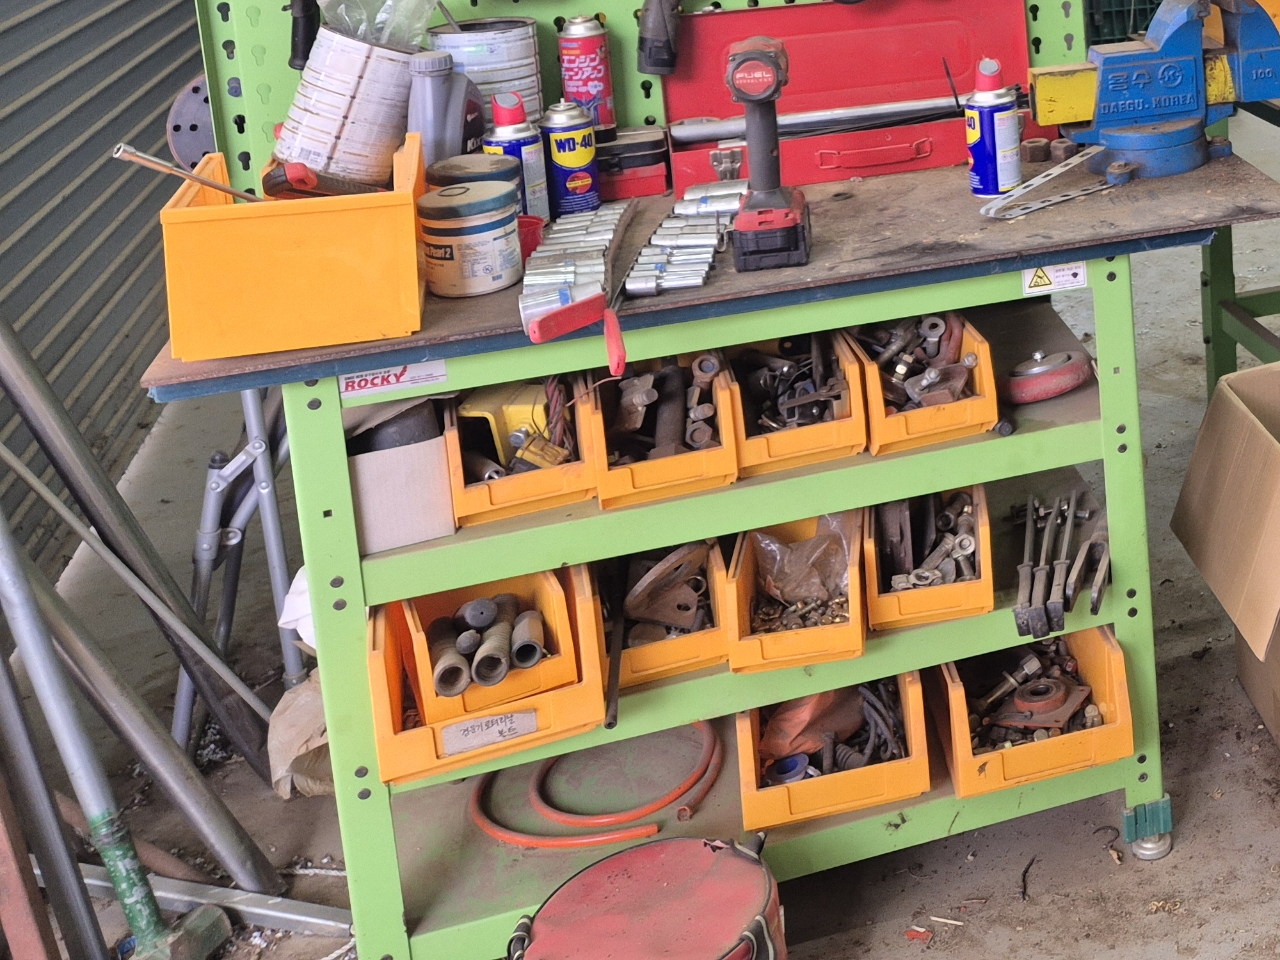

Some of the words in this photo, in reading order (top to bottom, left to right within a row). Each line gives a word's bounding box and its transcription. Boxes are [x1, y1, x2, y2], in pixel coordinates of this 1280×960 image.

[735, 71, 771, 80] FUEL
[1251, 68, 1273, 80] 100
[1152, 93, 1194, 109] KOREA
[554, 132, 593, 154] WD-40
[344, 368, 405, 391] ROCKY
